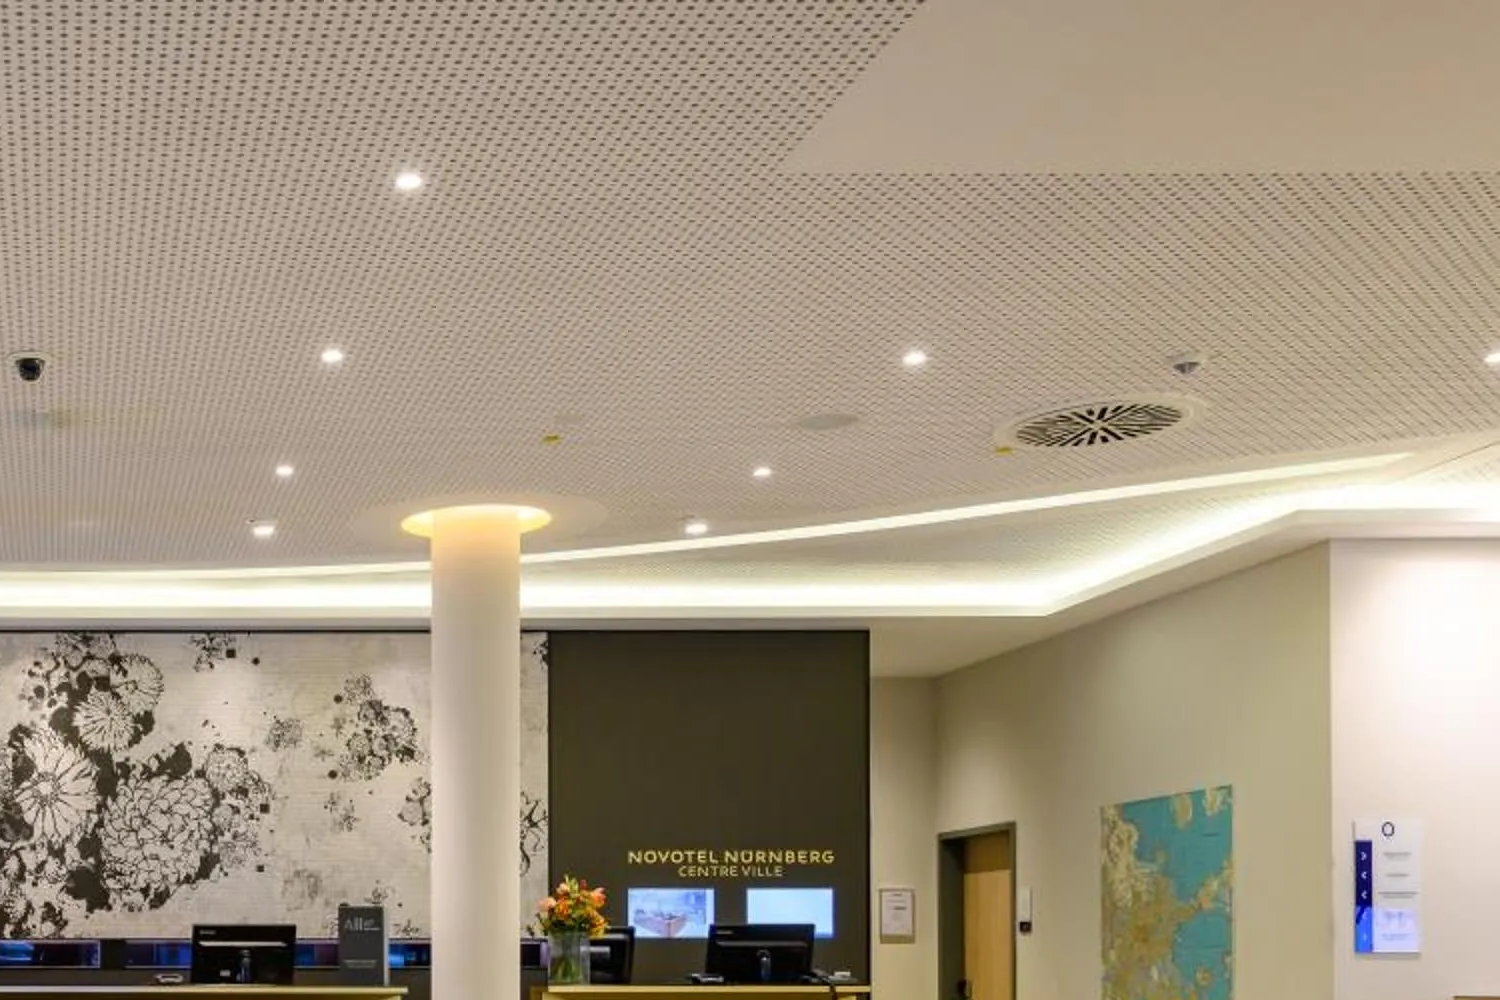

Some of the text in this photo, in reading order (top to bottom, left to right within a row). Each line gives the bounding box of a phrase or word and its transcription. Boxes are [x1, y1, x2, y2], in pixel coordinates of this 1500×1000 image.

[627, 850, 719, 864] NOVOTEL
[678, 865, 783, 877] CENTRE VILLE
